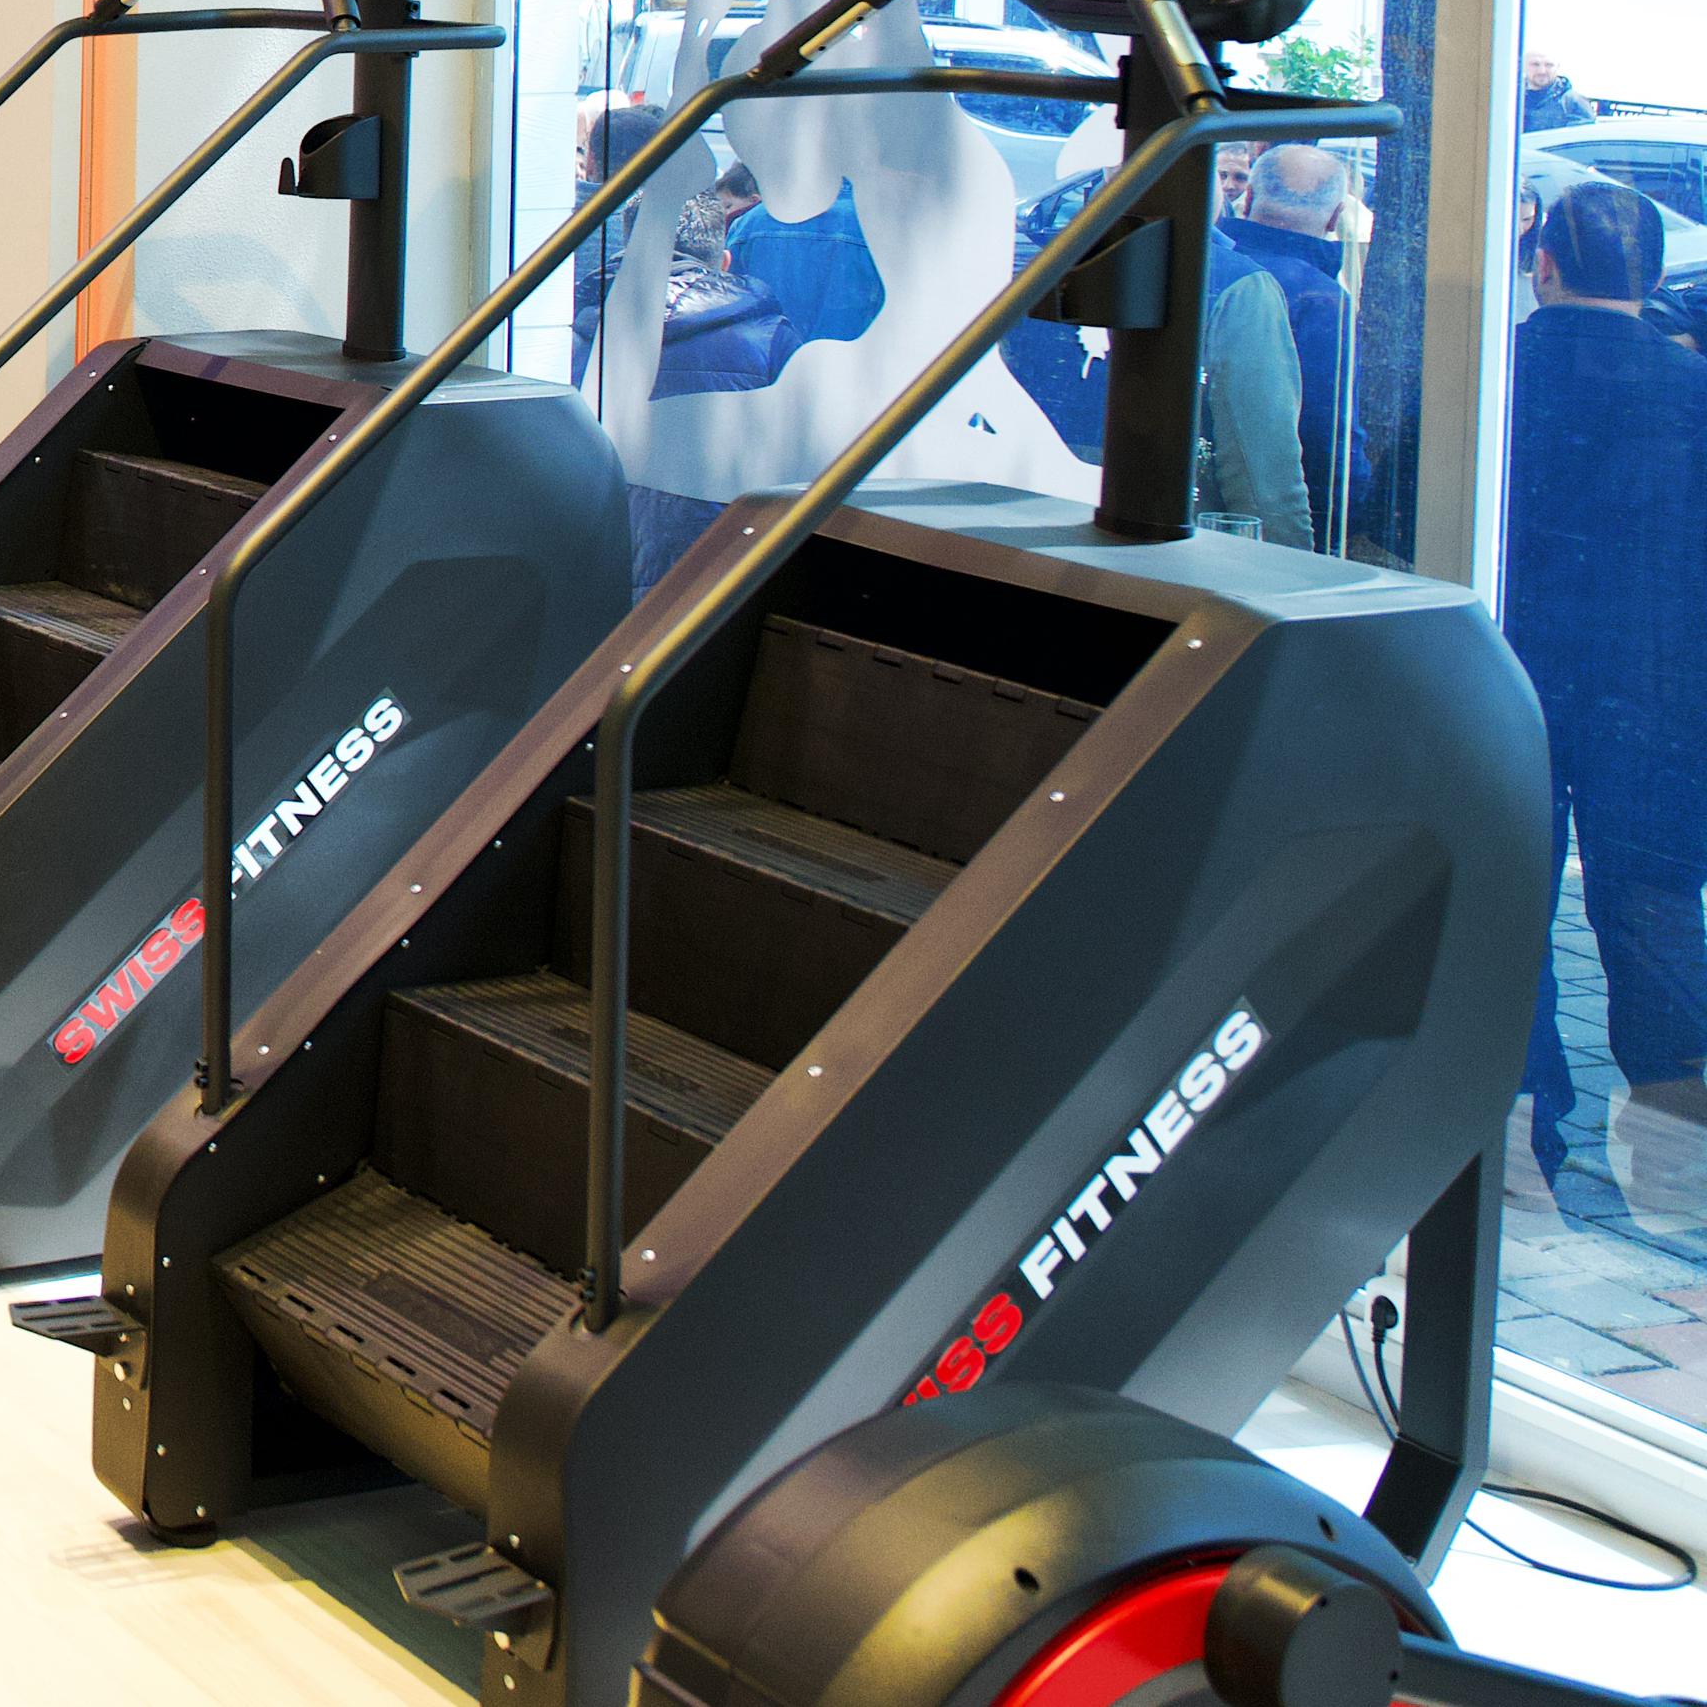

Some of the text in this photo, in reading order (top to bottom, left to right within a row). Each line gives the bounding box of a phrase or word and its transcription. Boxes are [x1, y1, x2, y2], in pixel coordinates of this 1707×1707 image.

[52, 697, 404, 1065] SWISS ITNESS
[1018, 1009, 1262, 1300] FITNESS
